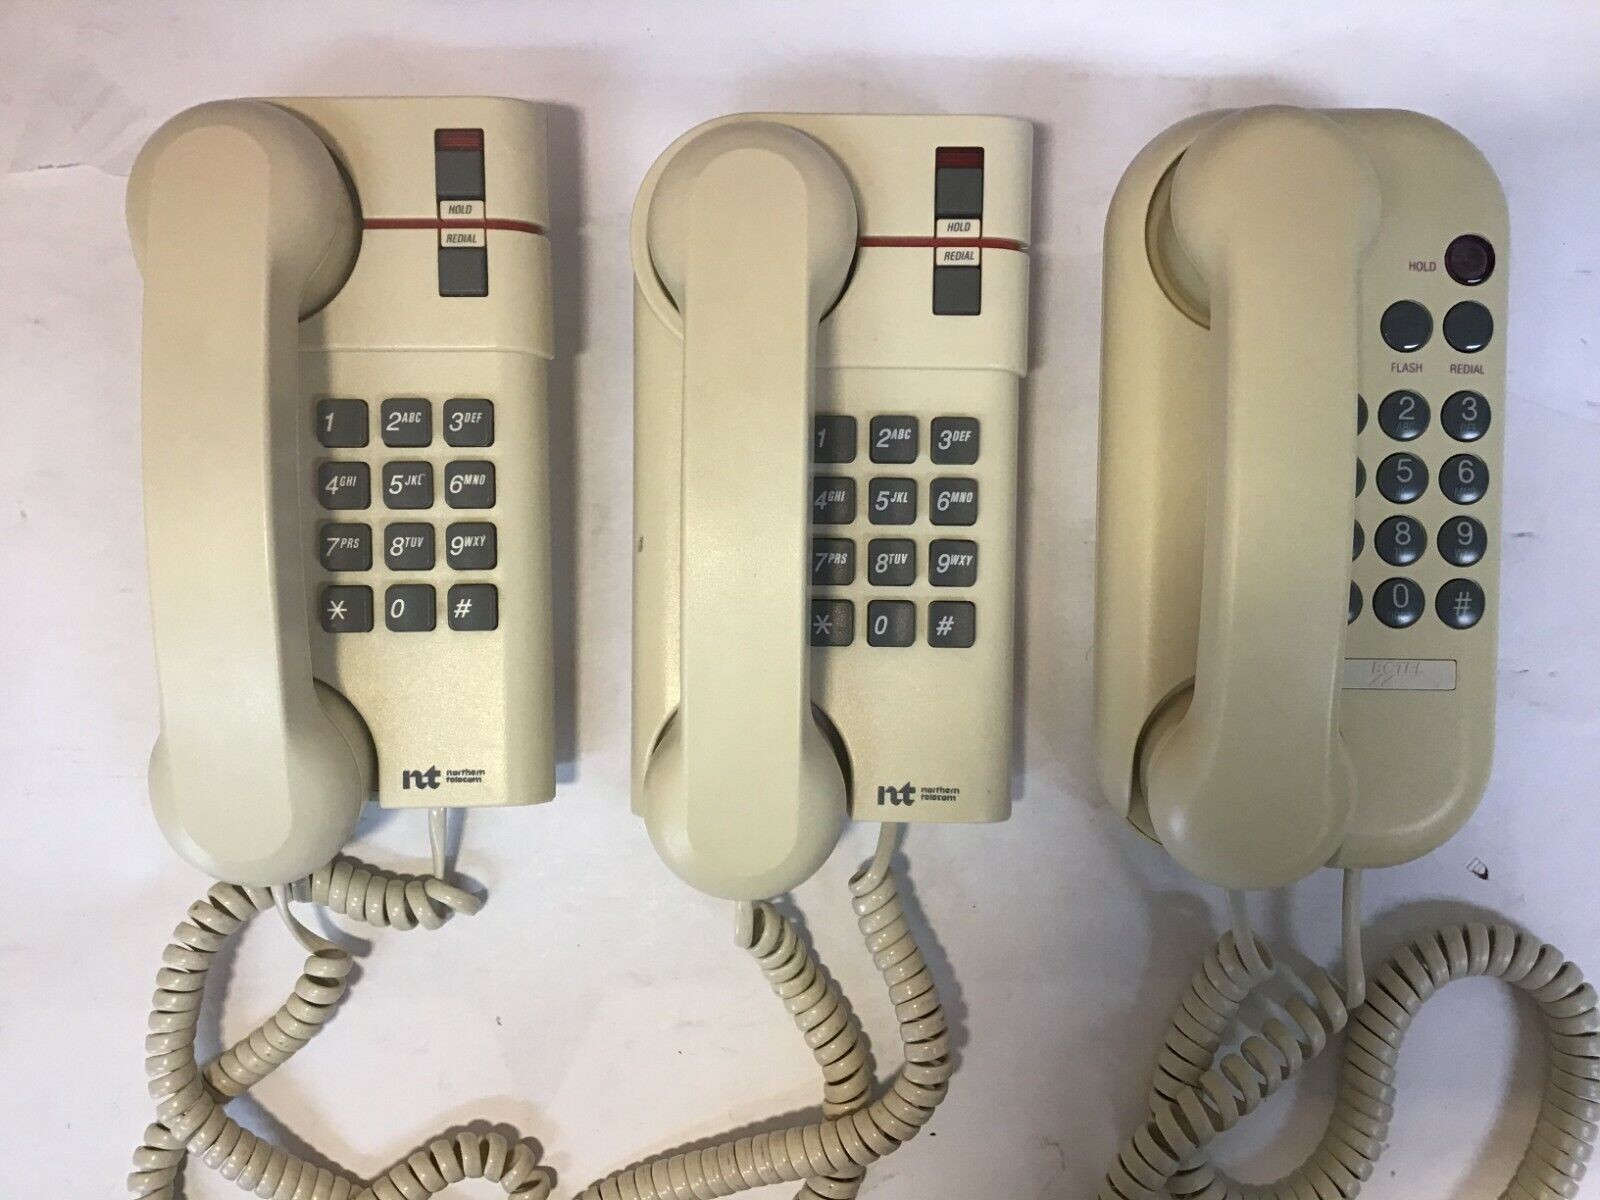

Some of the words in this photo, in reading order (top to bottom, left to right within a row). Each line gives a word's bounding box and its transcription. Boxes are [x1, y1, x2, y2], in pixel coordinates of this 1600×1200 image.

[448, 204, 472, 215] HOLD
[946, 221, 971, 232] HOLD
[446, 233, 477, 243] REDIAL
[944, 250, 975, 261] REDIAL
[1408, 261, 1437, 272] HOLD
[1390, 362, 1423, 373] FLASH
[1450, 363, 1485, 375] REDIAL
[1398, 396, 1416, 421] 2
[1461, 396, 1478, 421] 3
[325, 412, 334, 432] 1
[817, 428, 827, 448] 1
[1396, 458, 1413, 483] 5
[1458, 459, 1475, 484] 6
[1395, 521, 1412, 546] 8
[1456, 521, 1474, 546] 9
[1392, 583, 1409, 609] 0
[390, 598, 405, 619] 0
[453, 598, 473, 619] #
[874, 615, 888, 635] 0
[936, 615, 955, 636] #
